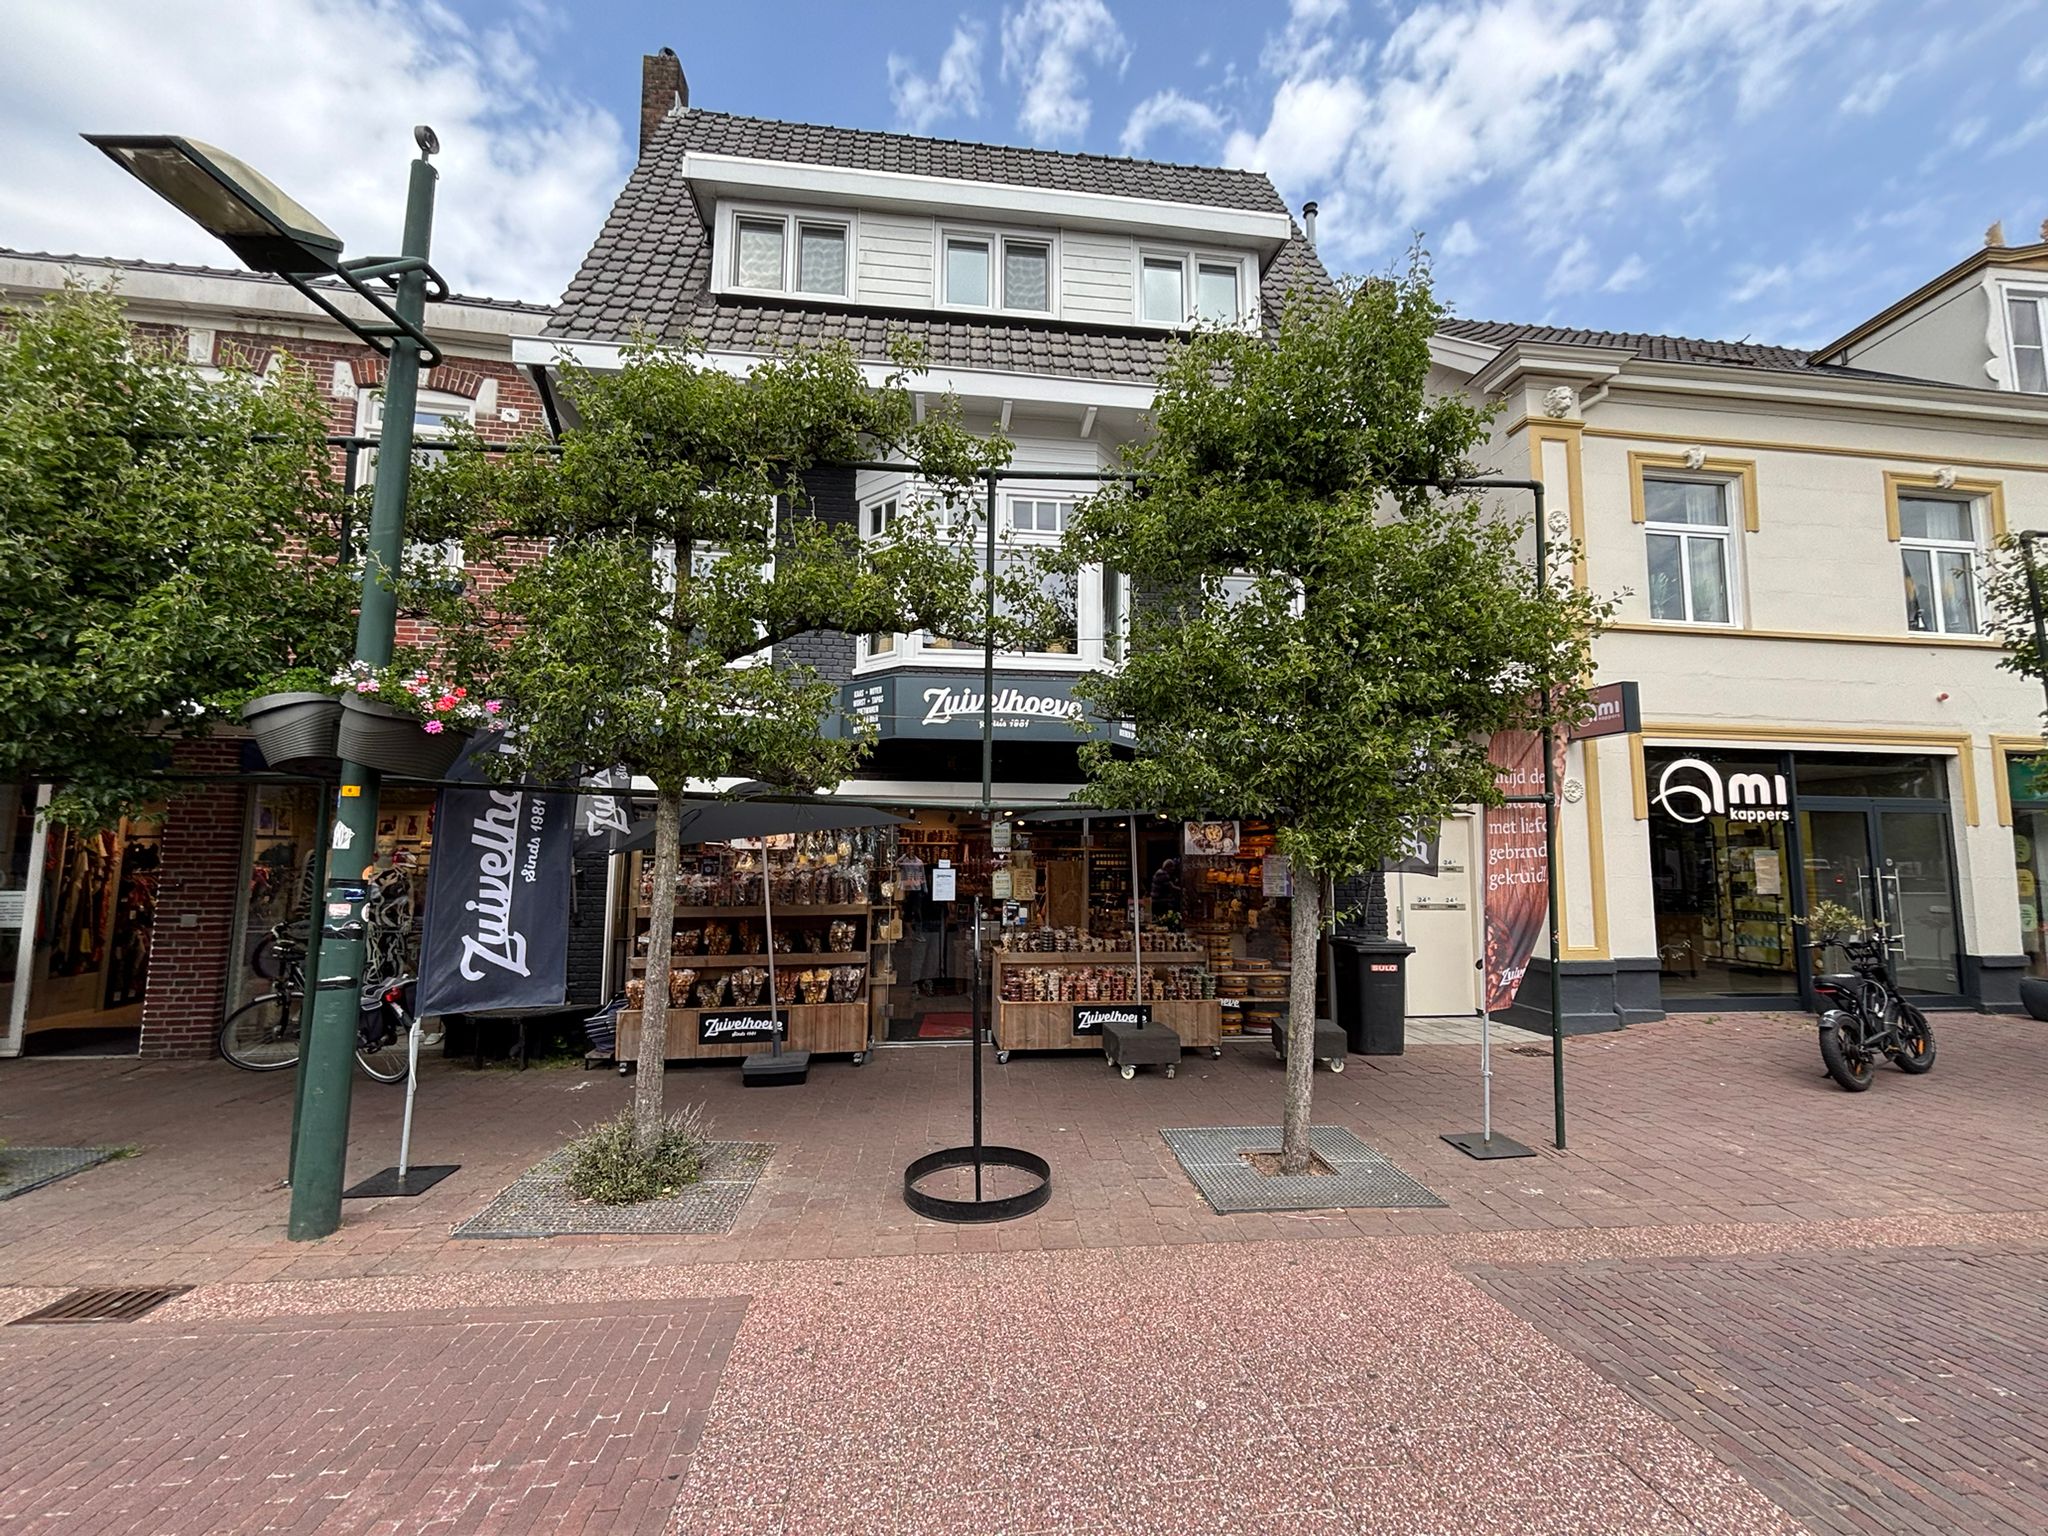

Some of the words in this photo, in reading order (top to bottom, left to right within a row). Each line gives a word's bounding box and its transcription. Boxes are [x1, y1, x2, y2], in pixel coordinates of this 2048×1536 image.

[1730, 807, 1790, 823] kappers
[1489, 821, 1517, 834] met
[1520, 817, 1547, 834] lief
[521, 836, 541, 883] Sinds
[532, 798, 546, 832] 1981
[1078, 1010, 1148, 1030] Zuivelhoee
